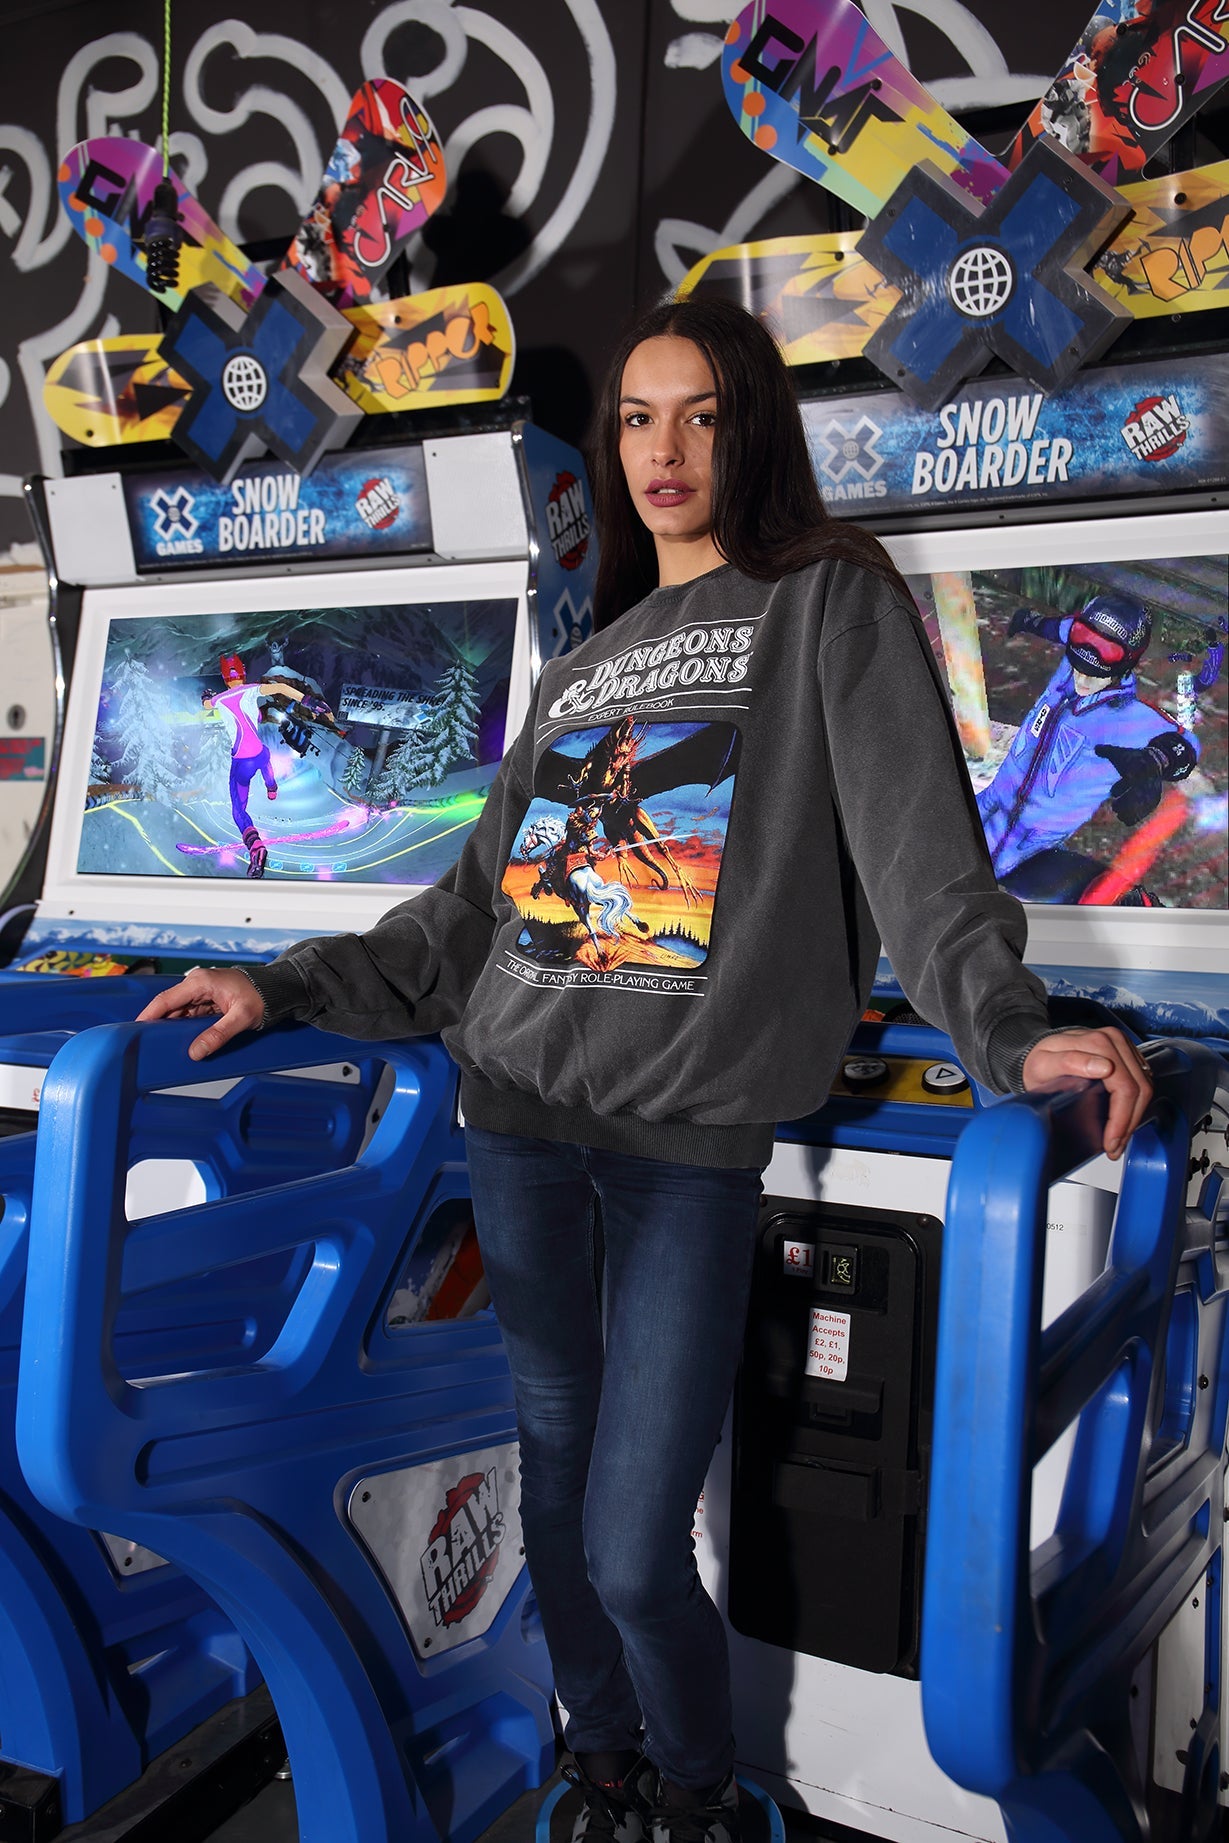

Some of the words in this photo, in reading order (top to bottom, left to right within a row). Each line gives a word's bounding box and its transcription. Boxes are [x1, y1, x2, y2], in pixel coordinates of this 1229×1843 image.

[935, 393, 1044, 449] SNOW
[1120, 394, 1181, 451] RAW
[1131, 415, 1190, 461] THRILLS
[911, 437, 1073, 496] BOARDER
[231, 474, 300, 515] SNOW
[355, 477, 394, 520] RAW
[545, 478, 585, 541] RAW
[822, 480, 887, 502] GAMES
[218, 508, 326, 552] BOARDER
[364, 495, 400, 529] THRILLS
[157, 538, 204, 557] GAMES
[551, 513, 590, 562] THRILLS
[585, 626, 754, 692] DUNGEONS
[342, 697, 368, 708] SINCE
[344, 686, 396, 701] SPREADING
[396, 692, 414, 703] THE
[548, 679, 595, 719] &
[591, 653, 751, 710] DRAGONS
[587, 707, 623, 722] EXPERT
[622, 698, 674, 715] RULEBOOK
[507, 959, 521, 973] THE
[580, 972, 659, 989] ROLE-PLAYING
[662, 979, 695, 991] GAME
[786, 1246, 812, 1267] £1
[812, 1311, 847, 1325] Machine
[812, 1325, 845, 1338] Accepts
[809, 1350, 826, 1362] 50p,
[828, 1353, 845, 1365] 20p,
[814, 1337, 827, 1349] £2,
[828, 1340, 841, 1350] £1,
[818, 1365, 834, 1375] 10p
[420, 1466, 500, 1601] RAW
[428, 1511, 507, 1627] THRILLS
